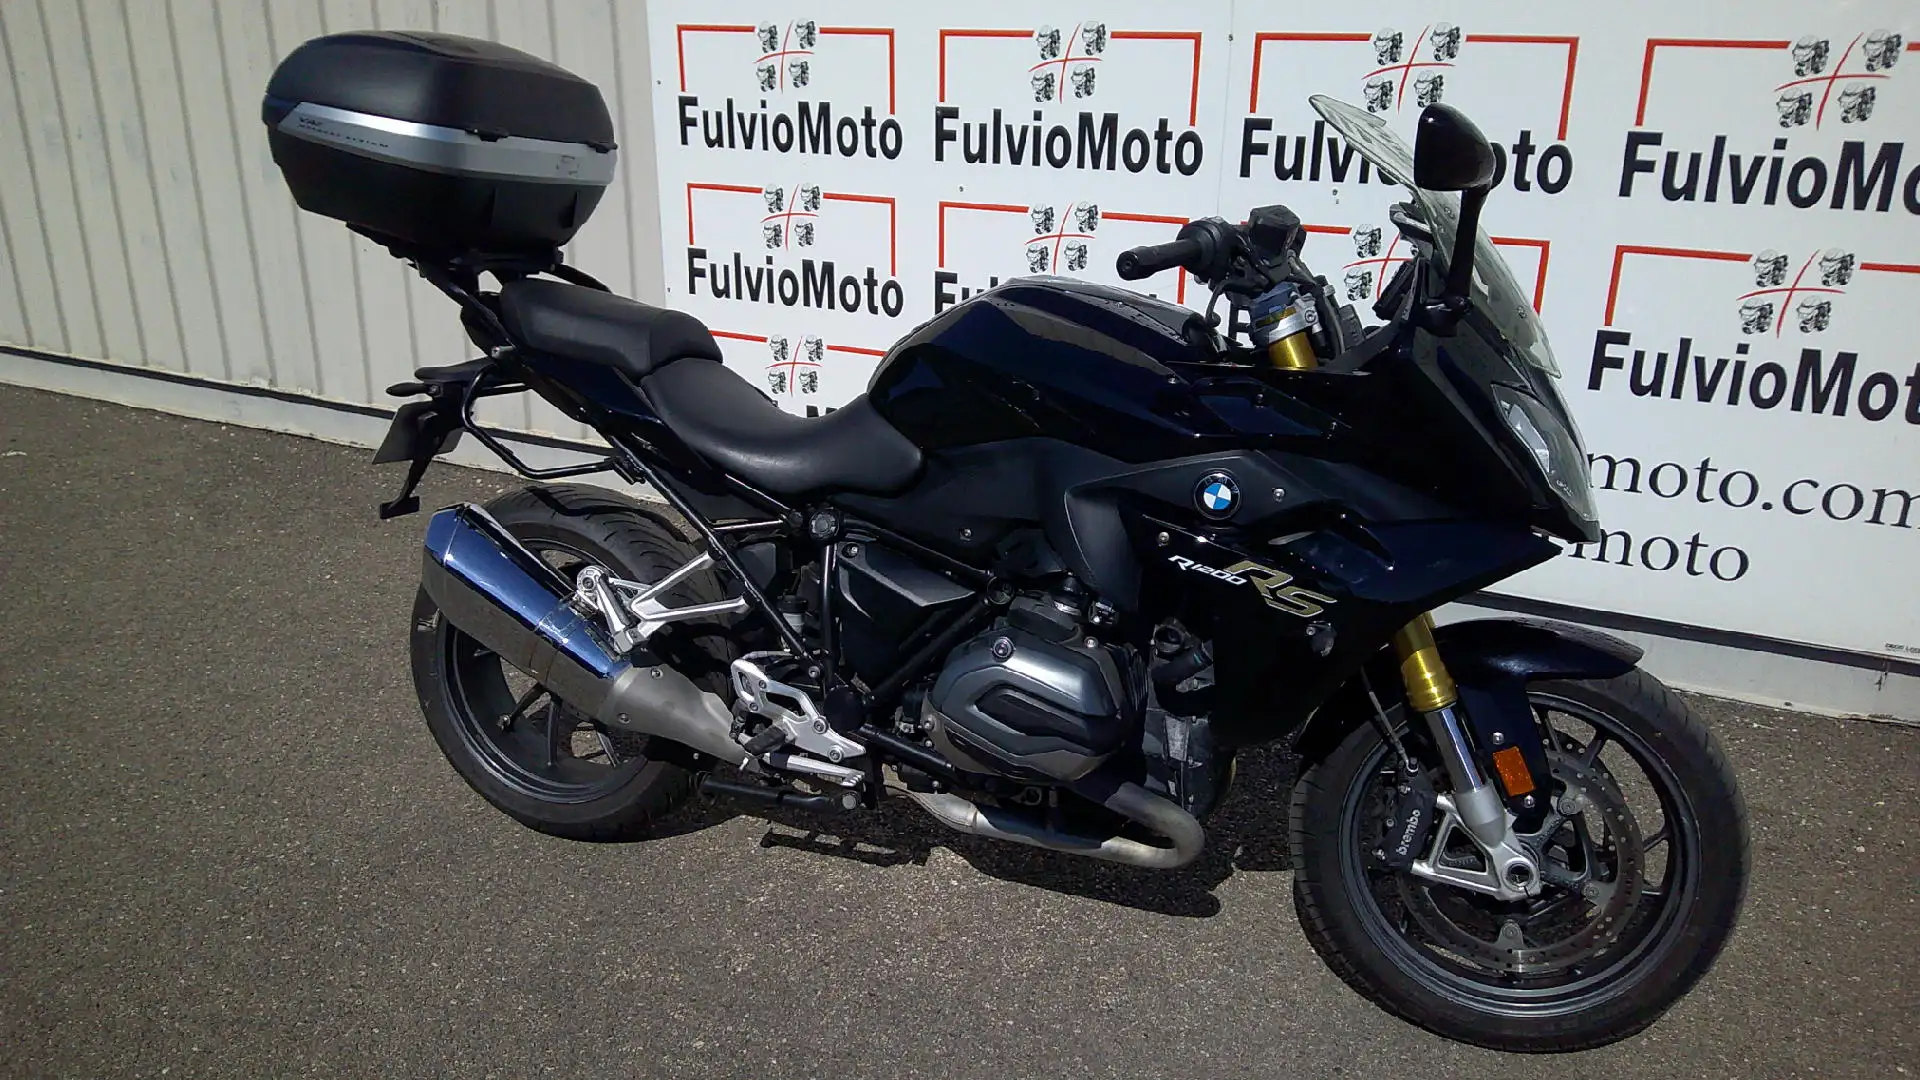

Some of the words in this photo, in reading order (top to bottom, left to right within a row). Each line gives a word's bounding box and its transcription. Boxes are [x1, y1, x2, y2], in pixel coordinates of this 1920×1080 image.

[678, 95, 903, 160] FulvioMoto
[935, 106, 1203, 177] FulvioMoto
[1239, 117, 1574, 195] Fulvto
[687, 247, 904, 318] FulvioMoto
[1223, 559, 1338, 618] RS
[1396, 808, 1422, 857] brembo
